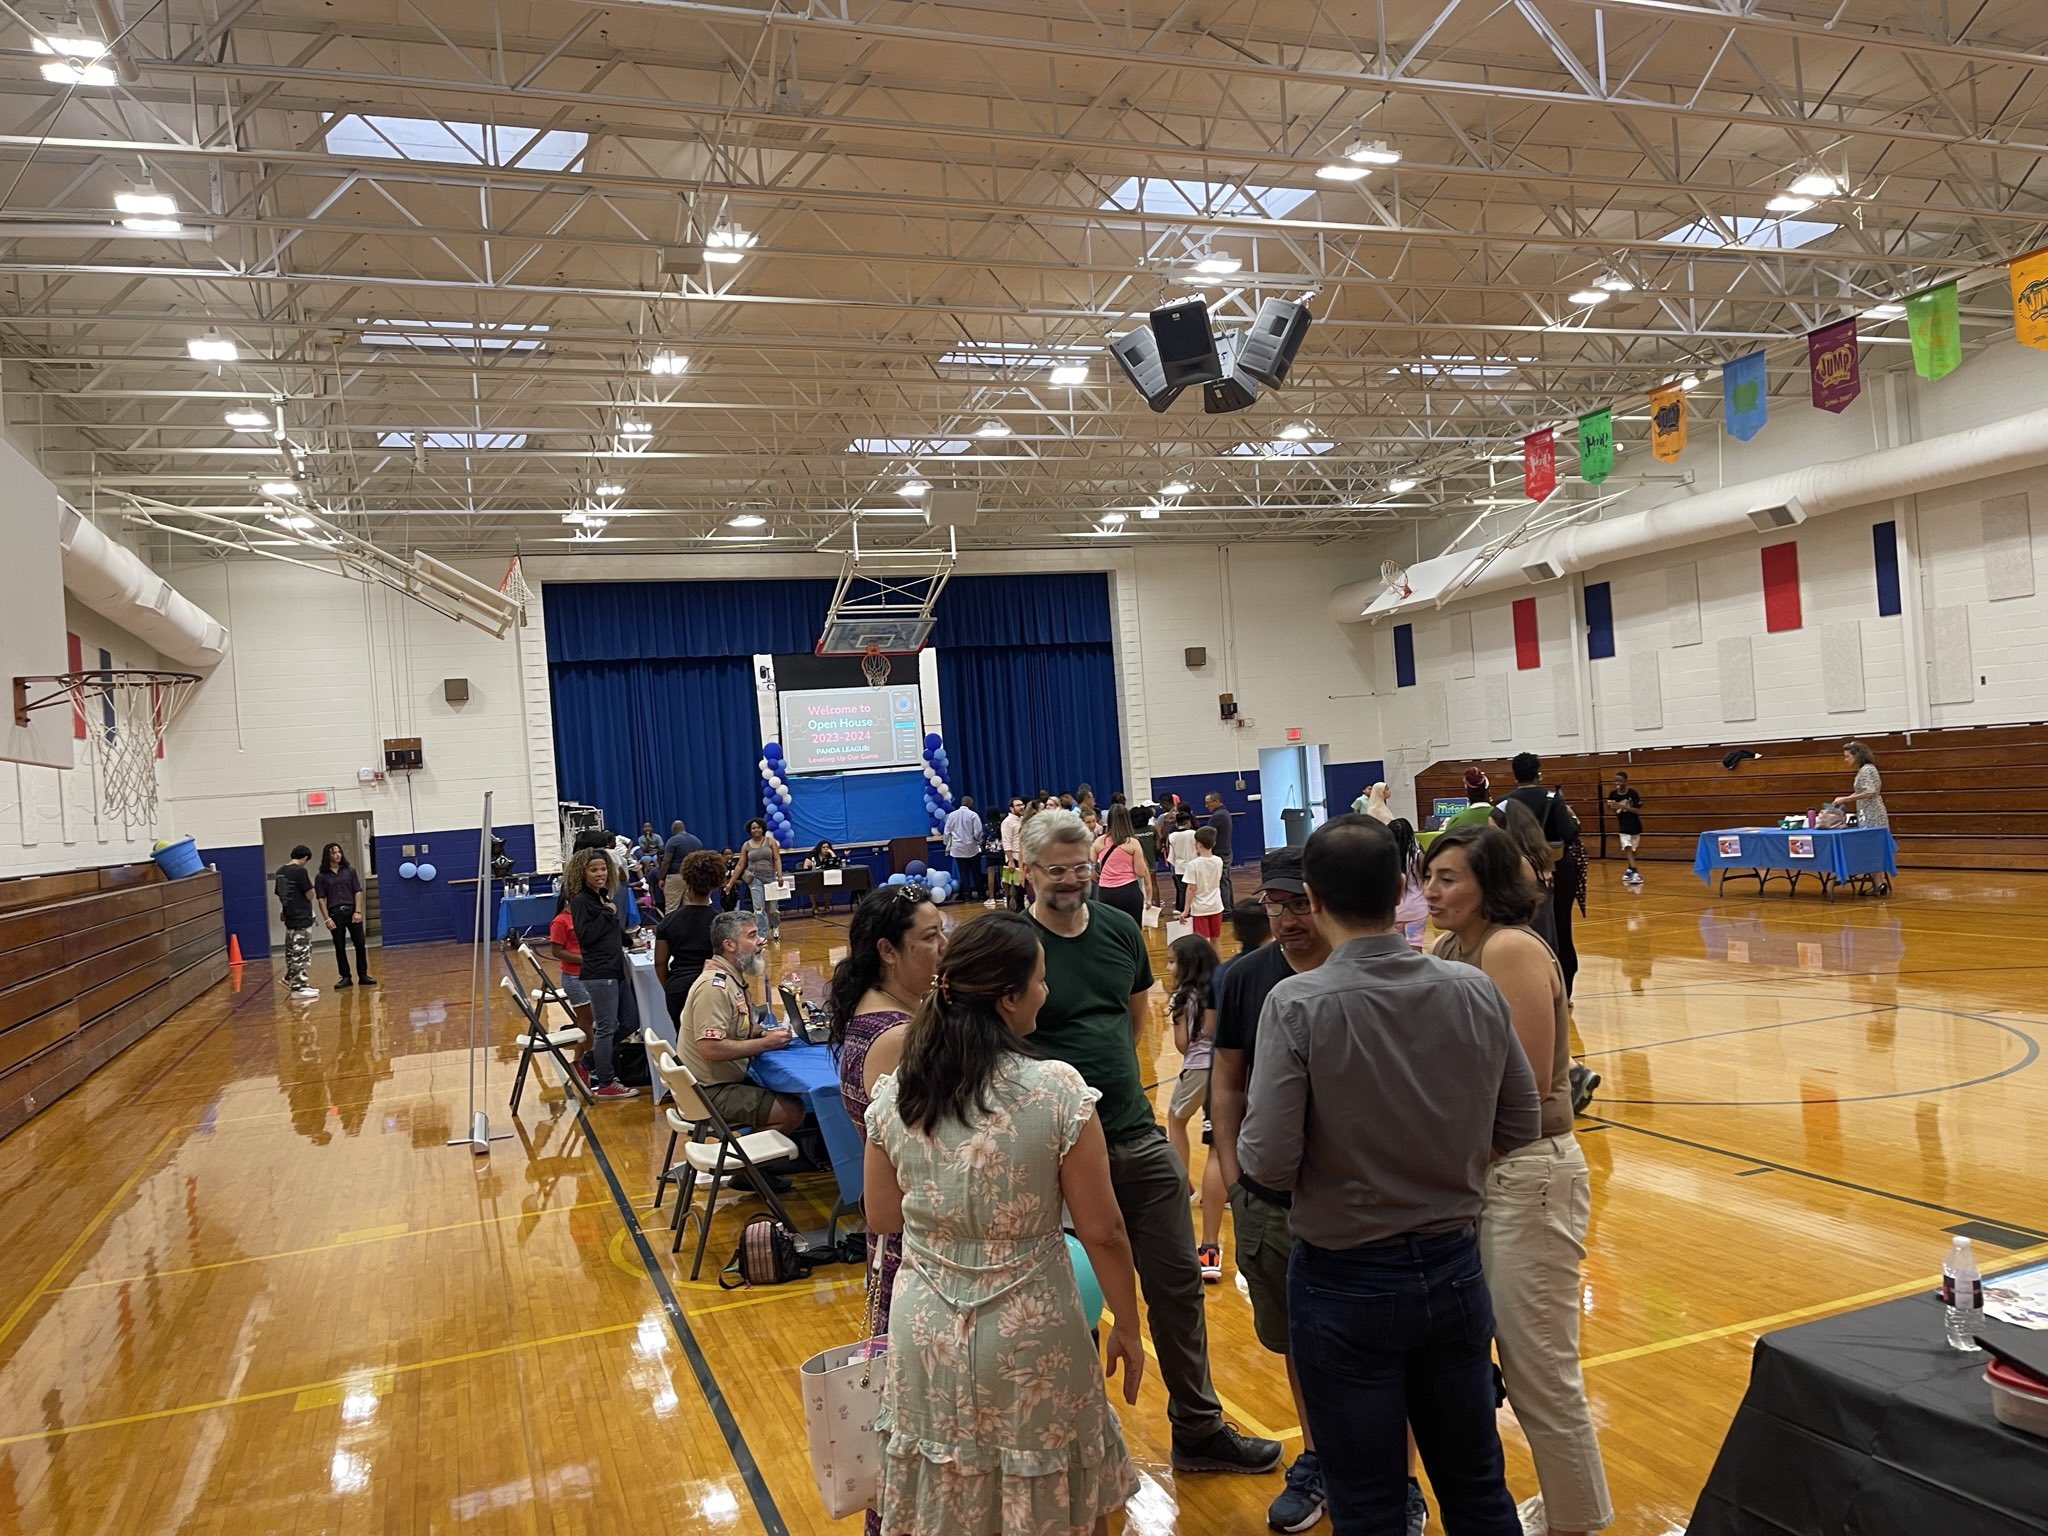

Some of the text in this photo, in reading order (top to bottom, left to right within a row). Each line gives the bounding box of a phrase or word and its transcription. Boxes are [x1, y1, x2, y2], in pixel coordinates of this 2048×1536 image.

[1821, 351, 1849, 377] JUMP
[808, 704, 871, 715] Welcome to
[808, 718, 873, 731] Open House
[812, 731, 871, 743] 2023-2024
[816, 747, 841, 755] PANDA
